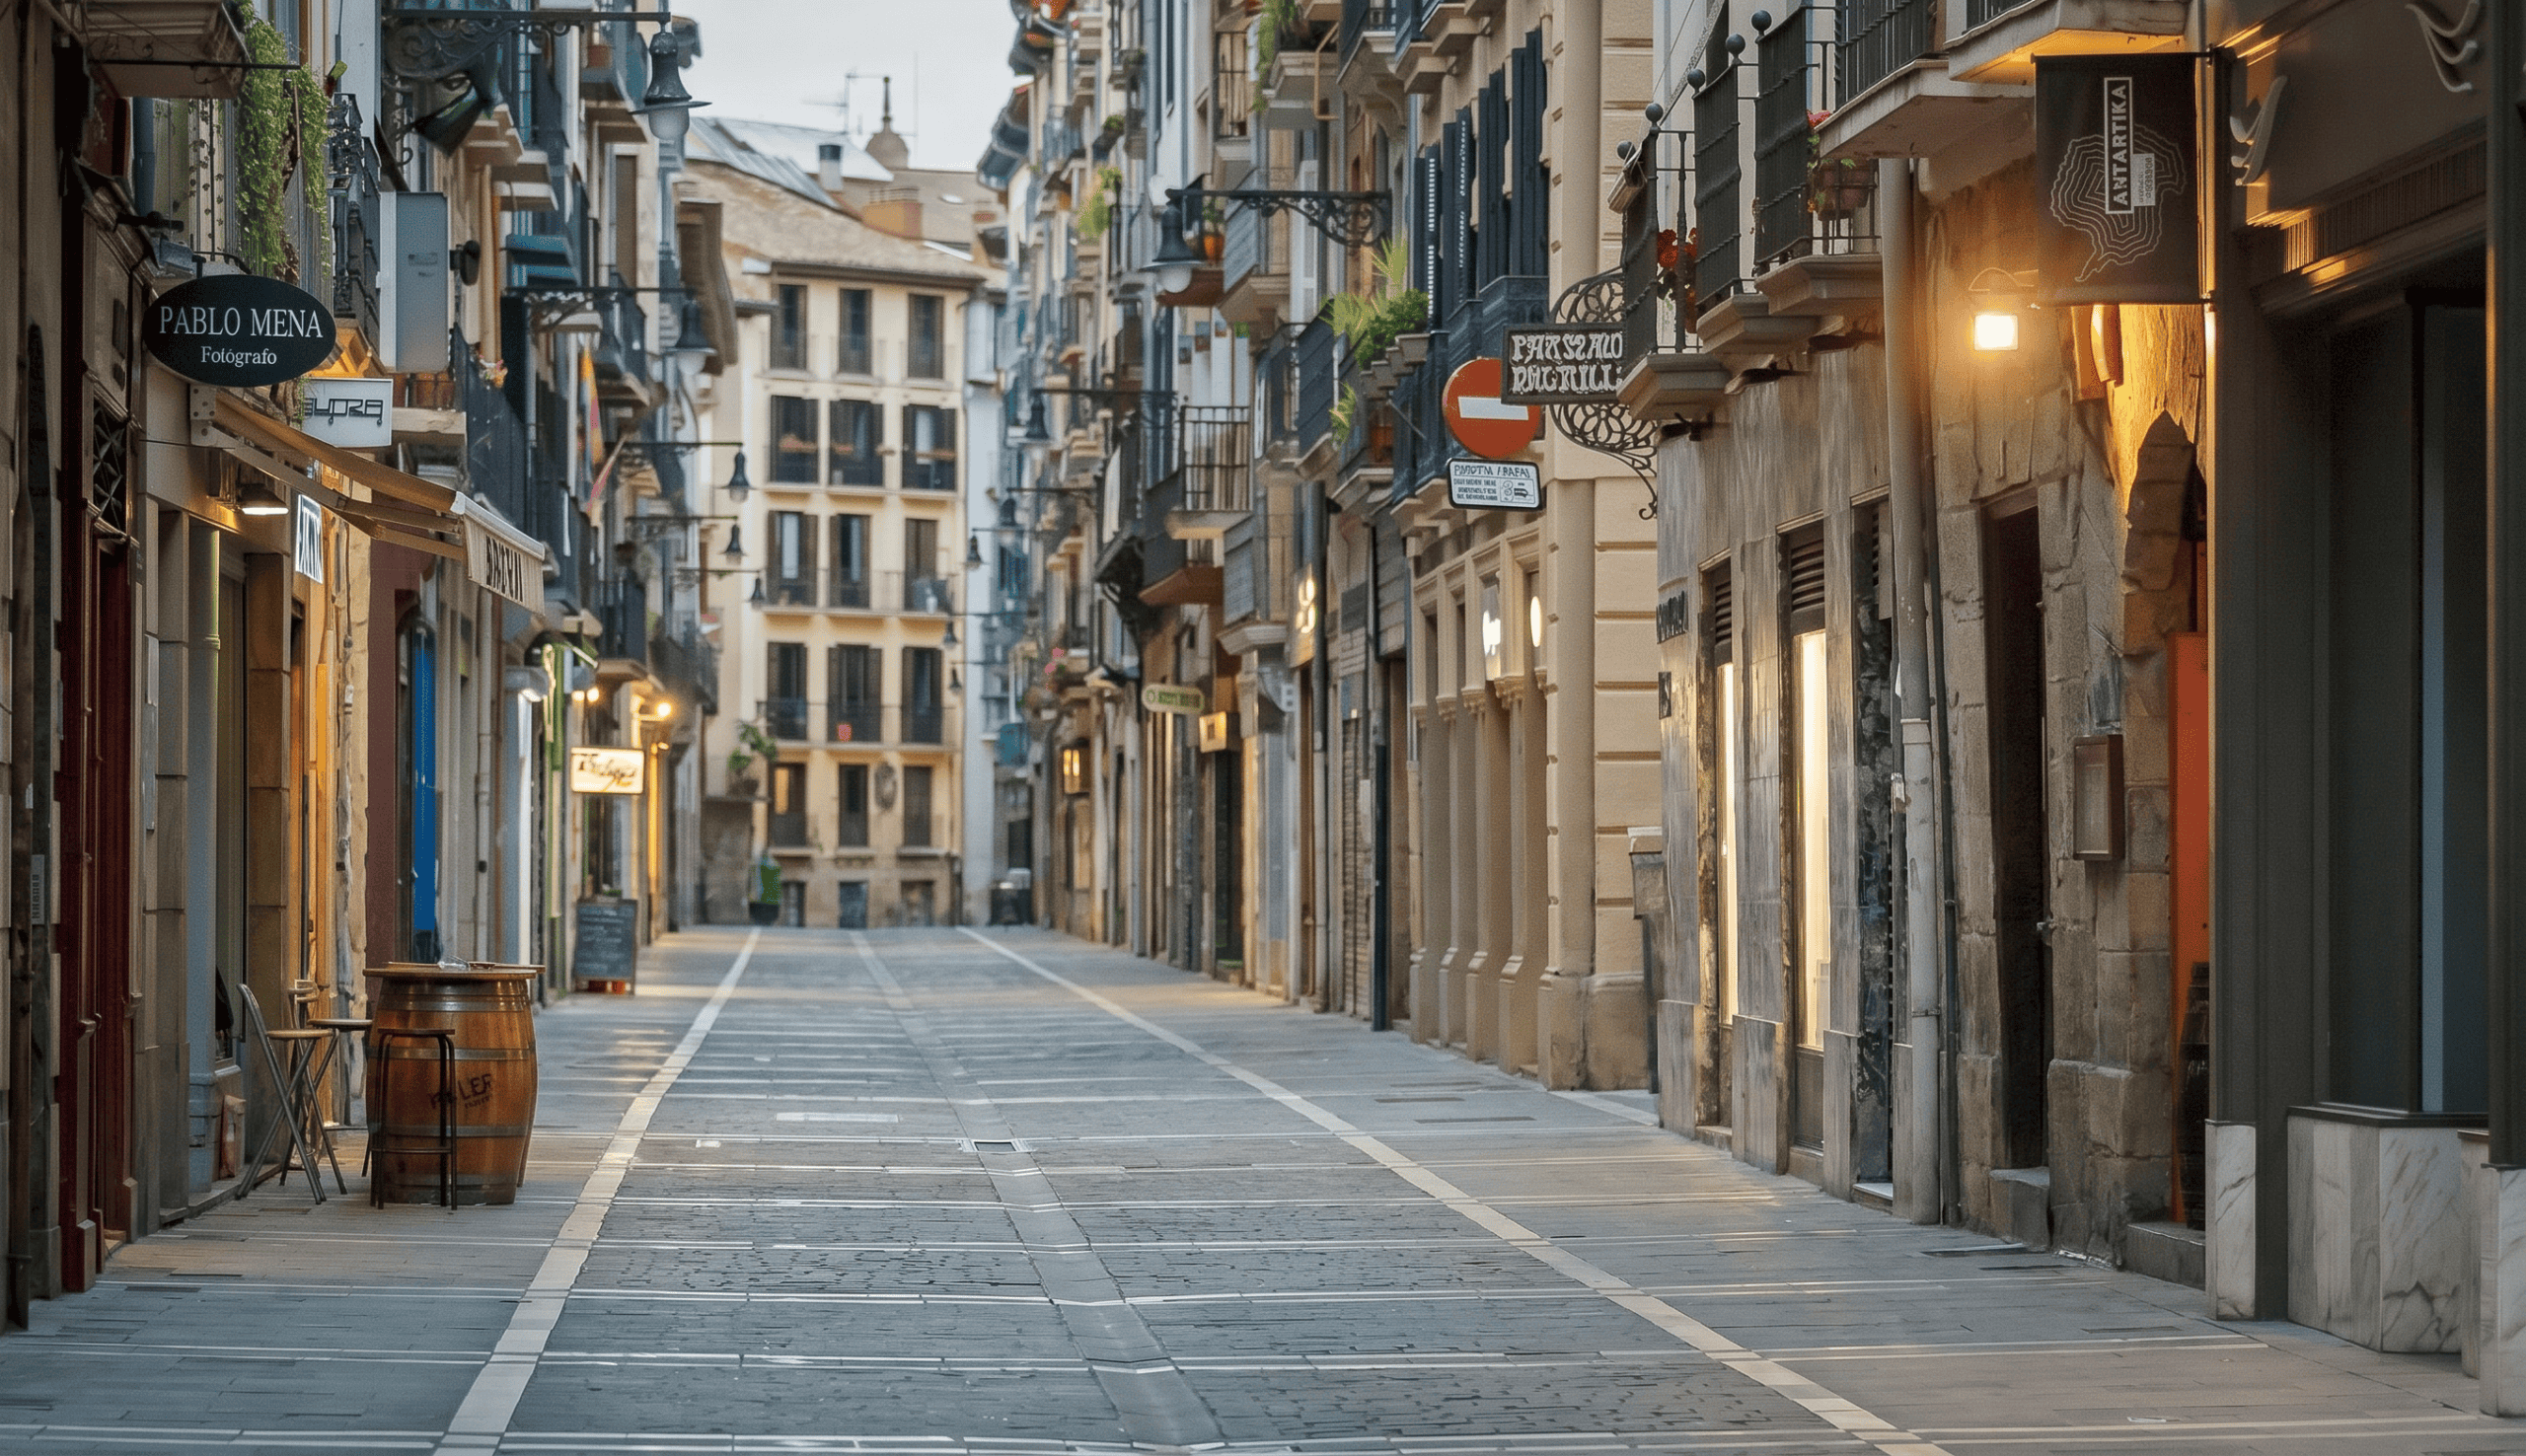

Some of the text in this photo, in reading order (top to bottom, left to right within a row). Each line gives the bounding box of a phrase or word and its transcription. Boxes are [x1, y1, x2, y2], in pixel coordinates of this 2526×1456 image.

[2111, 85, 2127, 206] ANTARTIKA
[159, 306, 324, 338] PABLO MENA
[200, 346, 277, 368] Fotógrafo
